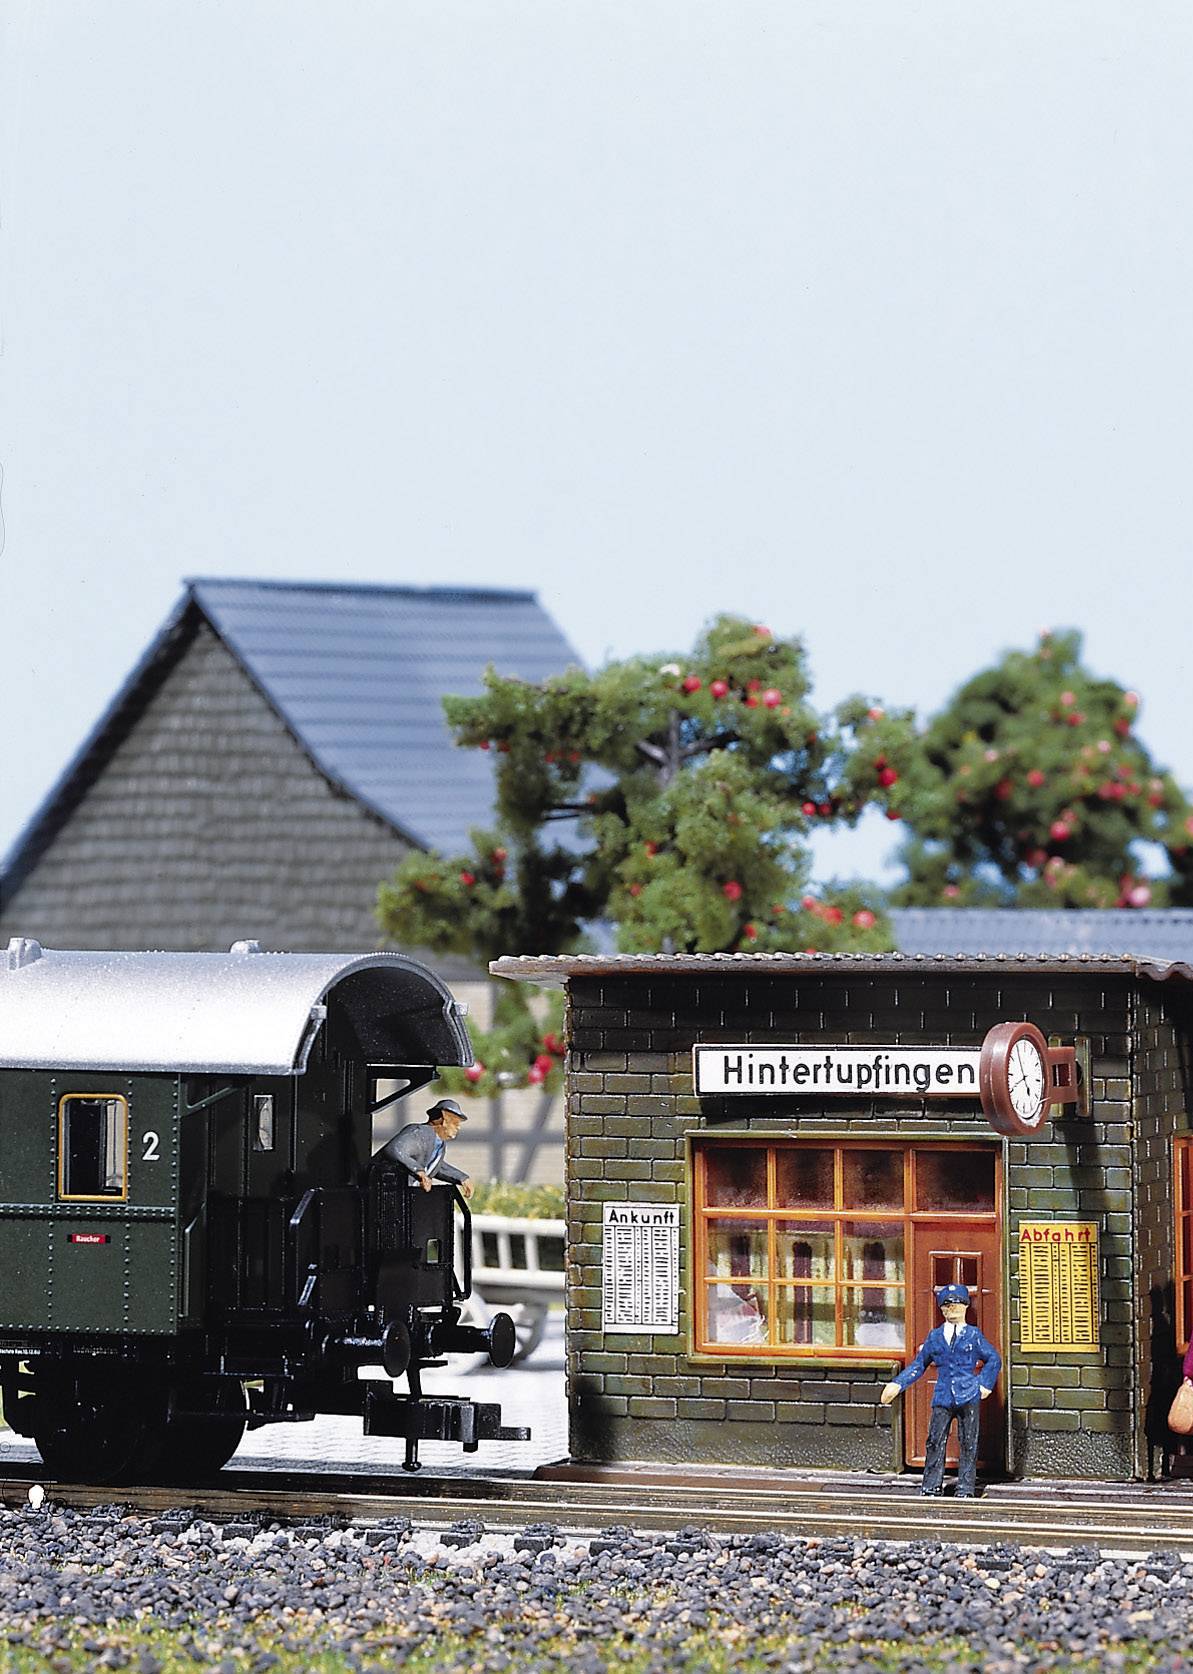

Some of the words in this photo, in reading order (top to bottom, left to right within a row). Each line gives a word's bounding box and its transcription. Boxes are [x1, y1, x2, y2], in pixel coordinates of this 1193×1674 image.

[723, 1053, 975, 1093] Hintertupfingen
[142, 1131, 160, 1161] 2
[609, 1209, 674, 1224] Ankunft
[1021, 1228, 1091, 1242] Abfahrt
